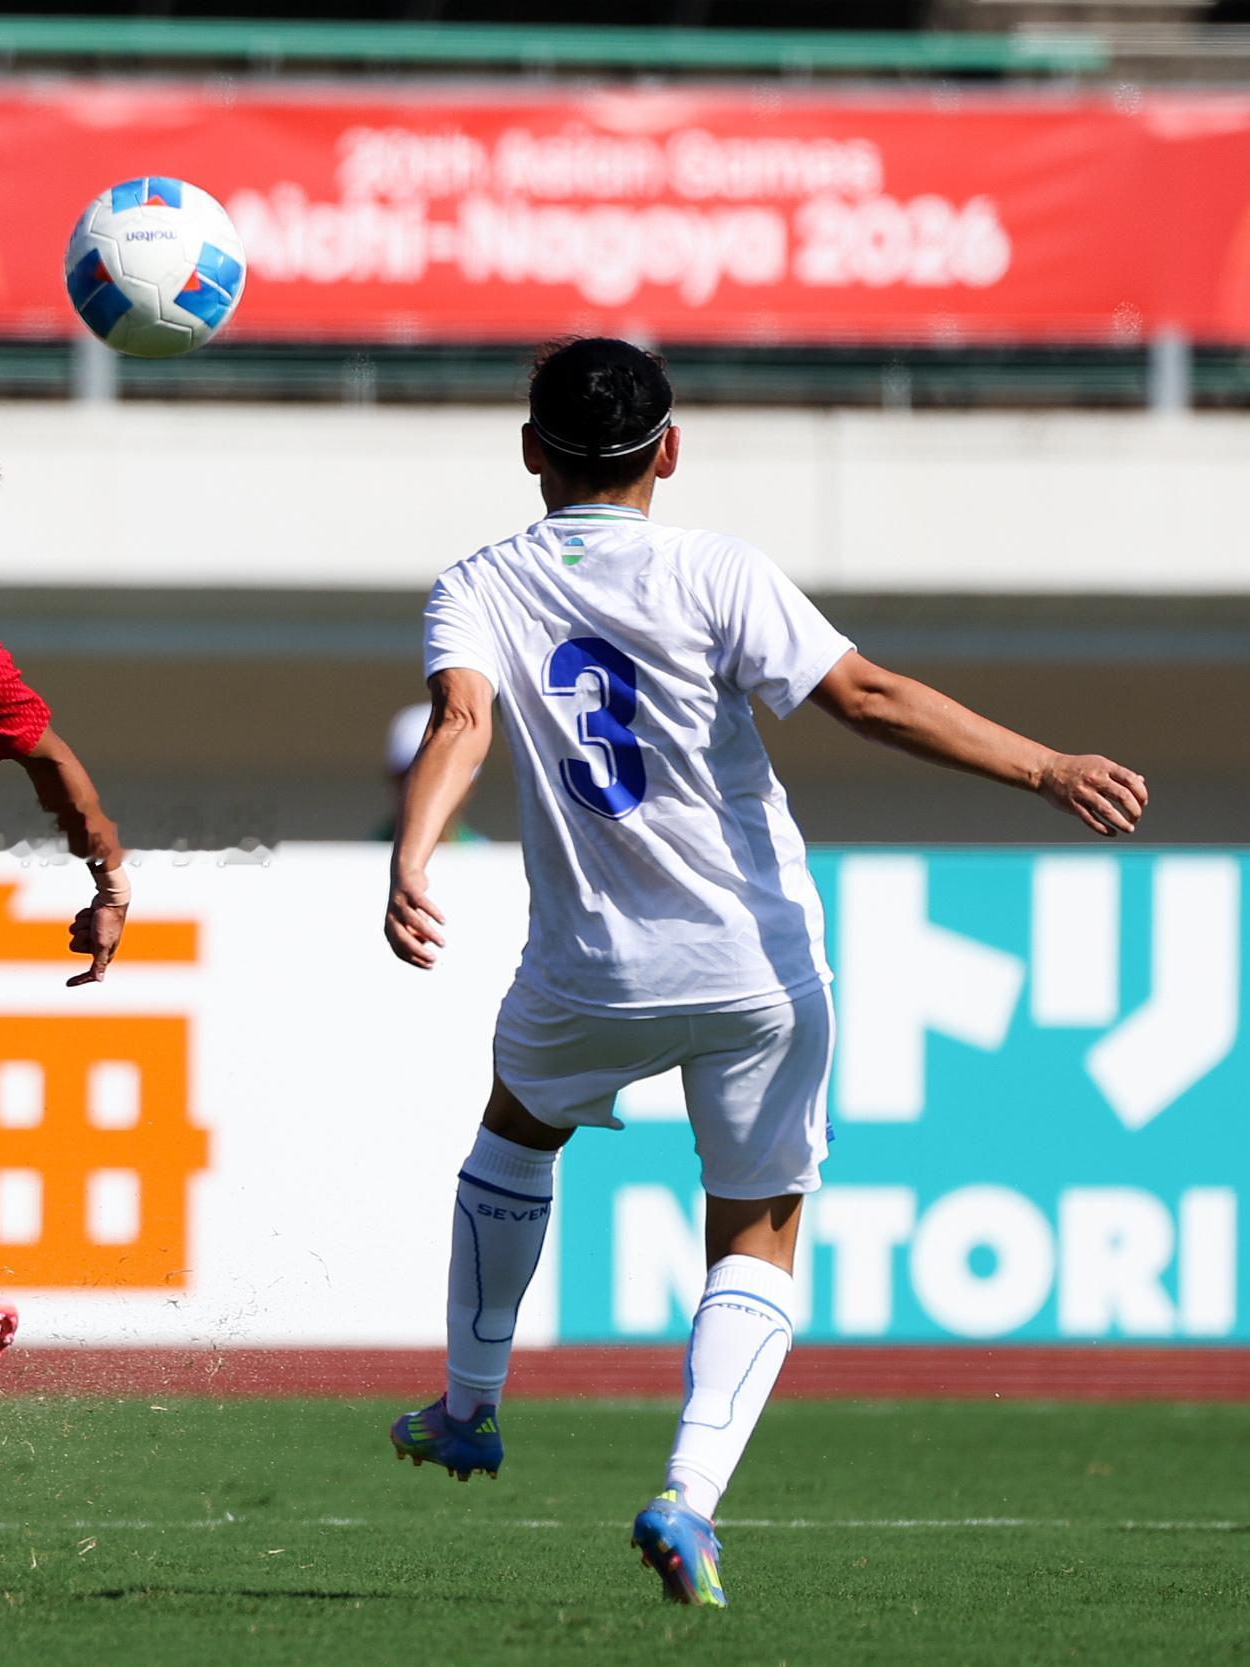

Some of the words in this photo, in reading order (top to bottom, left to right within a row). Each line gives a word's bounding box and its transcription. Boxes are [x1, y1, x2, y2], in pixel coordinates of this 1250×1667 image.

[338, 127, 490, 198] 20th
[493, 124, 664, 198] Asian
[667, 128, 883, 199] Games
[126, 230, 178, 242] molten
[232, 182, 788, 306] Aichi-Nagoya
[793, 194, 1011, 287] 2026
[542, 637, 647, 821] 3
